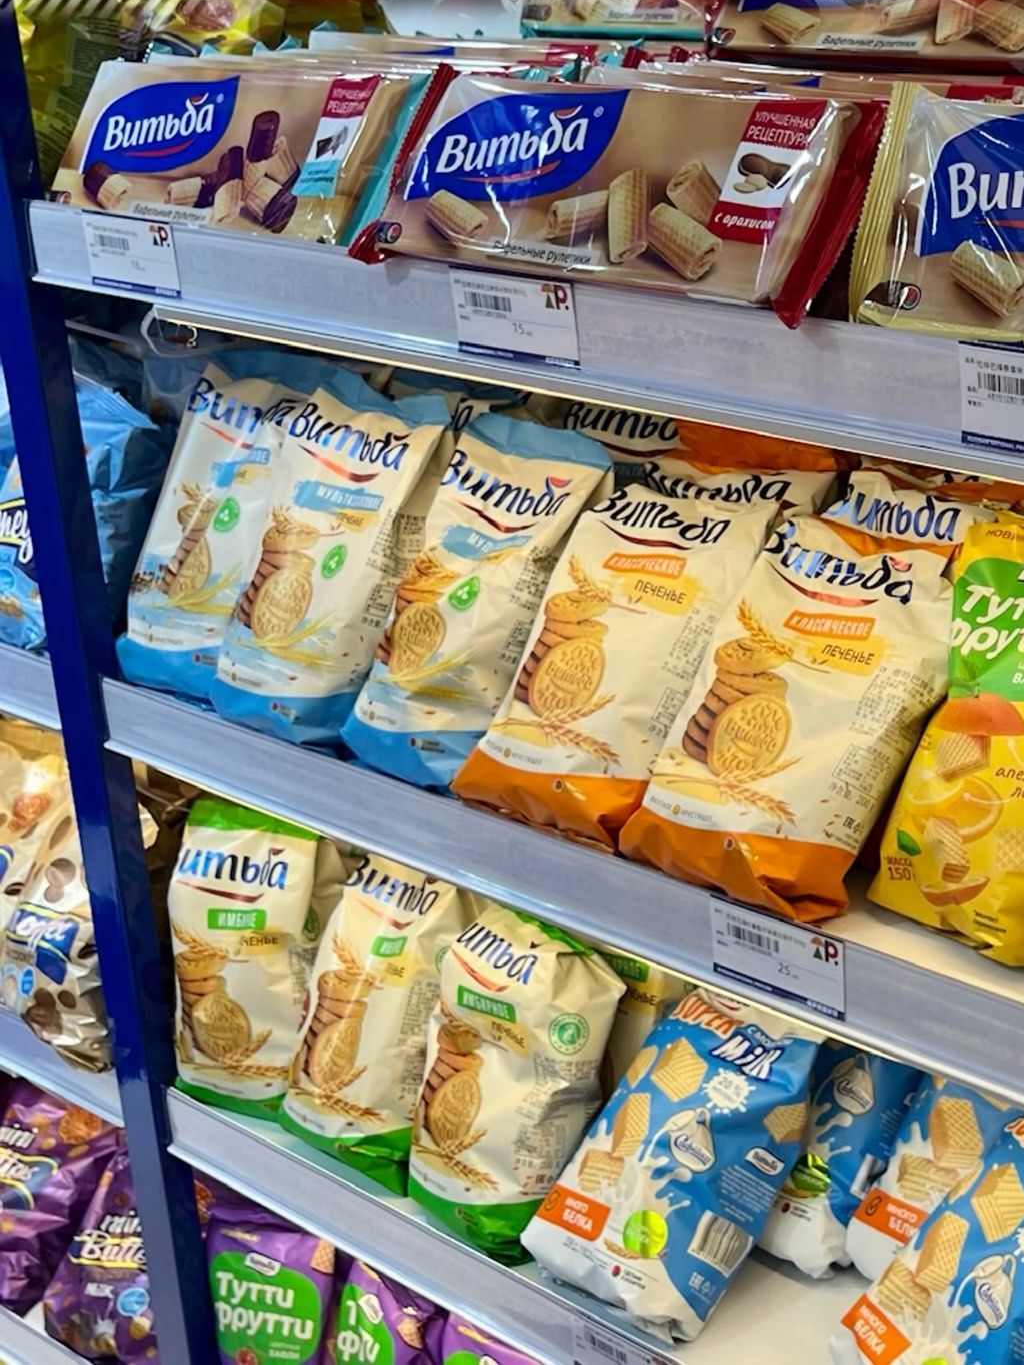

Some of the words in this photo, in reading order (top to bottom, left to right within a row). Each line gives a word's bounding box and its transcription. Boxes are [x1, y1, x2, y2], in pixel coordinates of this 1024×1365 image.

[821, 32, 870, 48] Вафельные
[871, 35, 918, 52] рулетики
[103, 93, 216, 152] Витьба
[746, 125, 811, 147] РЕЦЕПТУРА
[753, 110, 817, 130] УЛУЧШЕННАЯ
[435, 104, 590, 174] Витьба
[723, 211, 776, 230] арахисом
[545, 249, 591, 267] рулетики
[288, 401, 412, 472] Витьба
[440, 448, 573, 518] Витьба
[590, 486, 733, 545] Витьба
[763, 519, 914, 606] Витьба
[634, 579, 688, 605] ПЕЧЕНЬЕ
[788, 616, 872, 638] КЛАССИЧЕСКОЕ
[820, 643, 876, 667] ПЕЧЕНЬЕ
[178, 847, 288, 891] итьба
[456, 922, 538, 986] итьба
[671, 991, 746, 1038] SUPER
[711, 1034, 784, 1081] MiLK
[561, 1209, 594, 1234] БЕЛКА
[564, 1195, 590, 1214] МНОГО
[886, 1201, 918, 1223] МНОГО
[215, 1269, 296, 1309] Тутти
[859, 1303, 888, 1335] МНОГО
[852, 1319, 887, 1357] БЕЛКА
